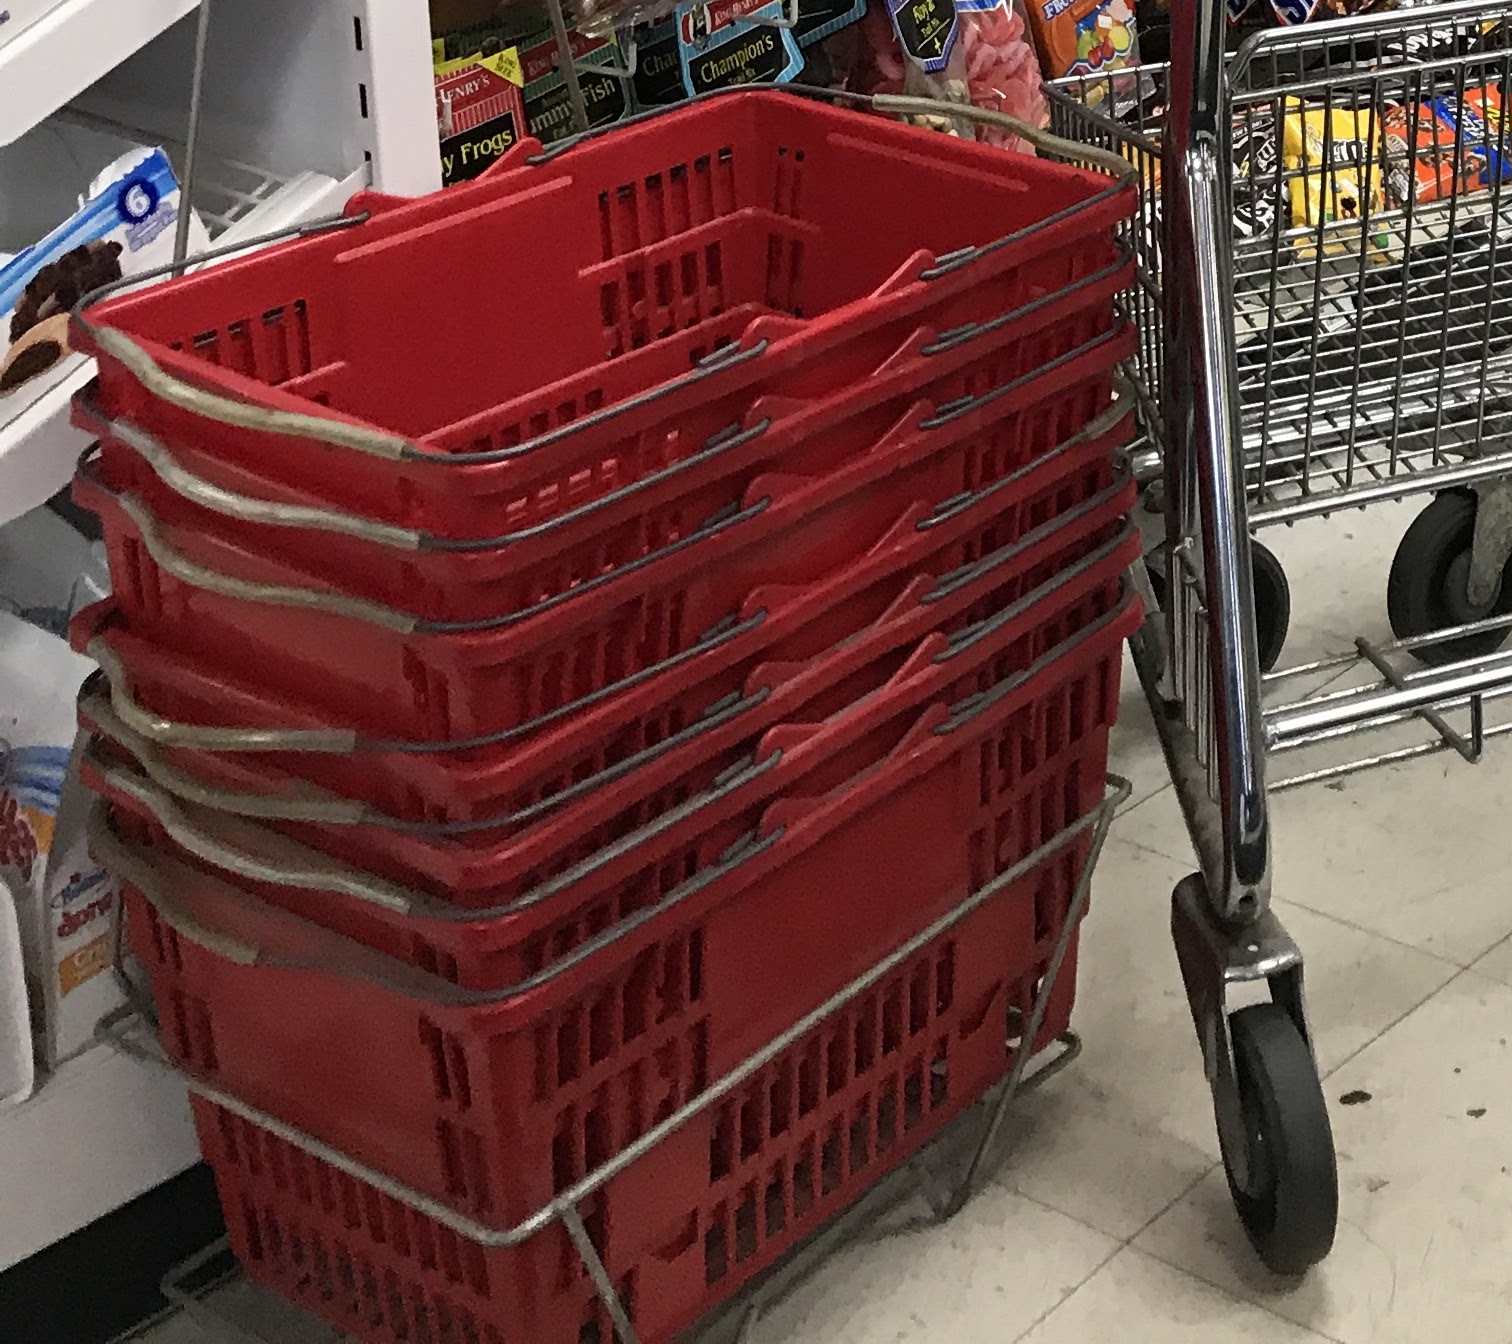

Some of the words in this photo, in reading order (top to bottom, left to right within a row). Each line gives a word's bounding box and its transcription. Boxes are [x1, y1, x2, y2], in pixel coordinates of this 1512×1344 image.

[700, 33, 775, 84] Champion's
[460, 128, 514, 166] Frogs
[125, 183, 151, 218] 6
